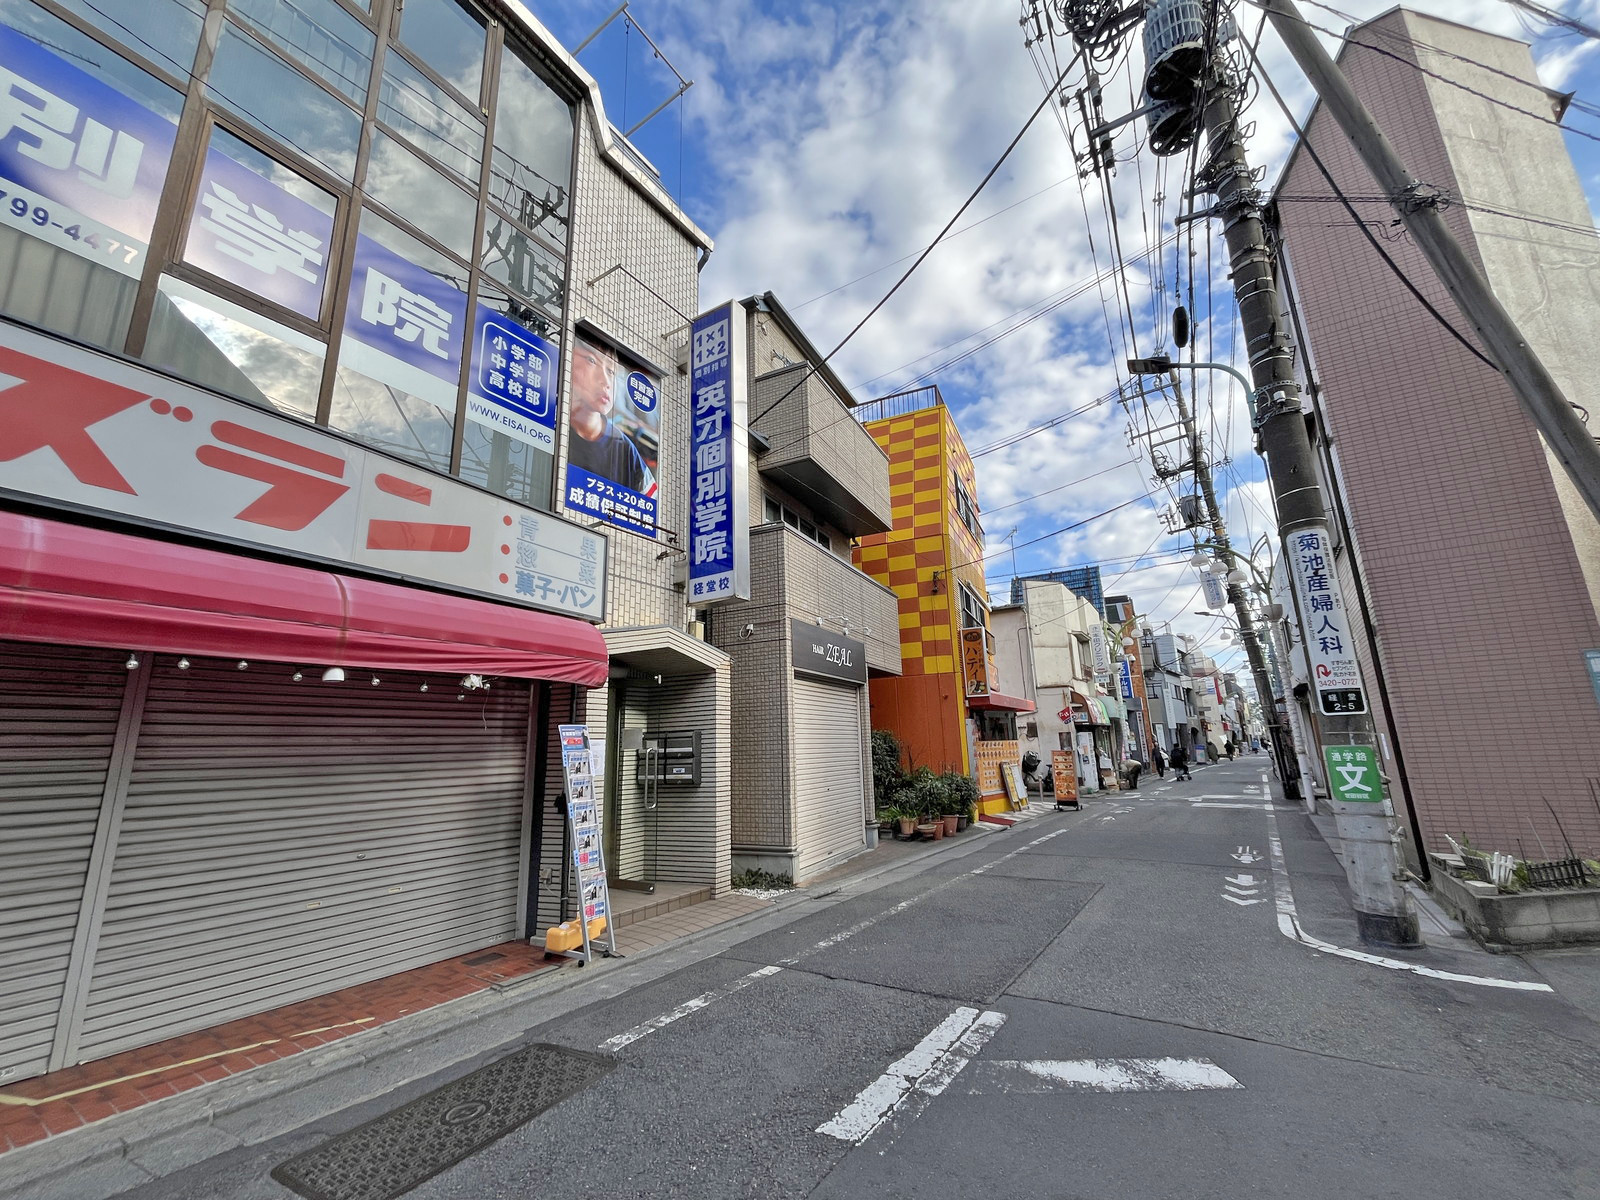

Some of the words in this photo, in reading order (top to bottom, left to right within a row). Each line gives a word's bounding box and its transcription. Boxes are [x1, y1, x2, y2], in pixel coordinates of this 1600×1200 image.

[490, 352, 542, 389] 中学部
[492, 335, 543, 372] 小学部
[489, 369, 541, 407] 高校部
[469, 401, 552, 444] WWW.EISAI.ORG
[695, 379, 728, 566] 英才個別学院
[569, 487, 655, 532] 成績保証制度
[514, 570, 597, 609] 菓子・パン
[693, 577, 730, 596] 経堂校
[1297, 532, 1343, 656] 菊池産婦人科
[826, 643, 853, 667] ZEAL
[1333, 702, 1355, 711] 2-5
[1331, 750, 1368, 761] 通学路
[1335, 762, 1373, 792] 文
